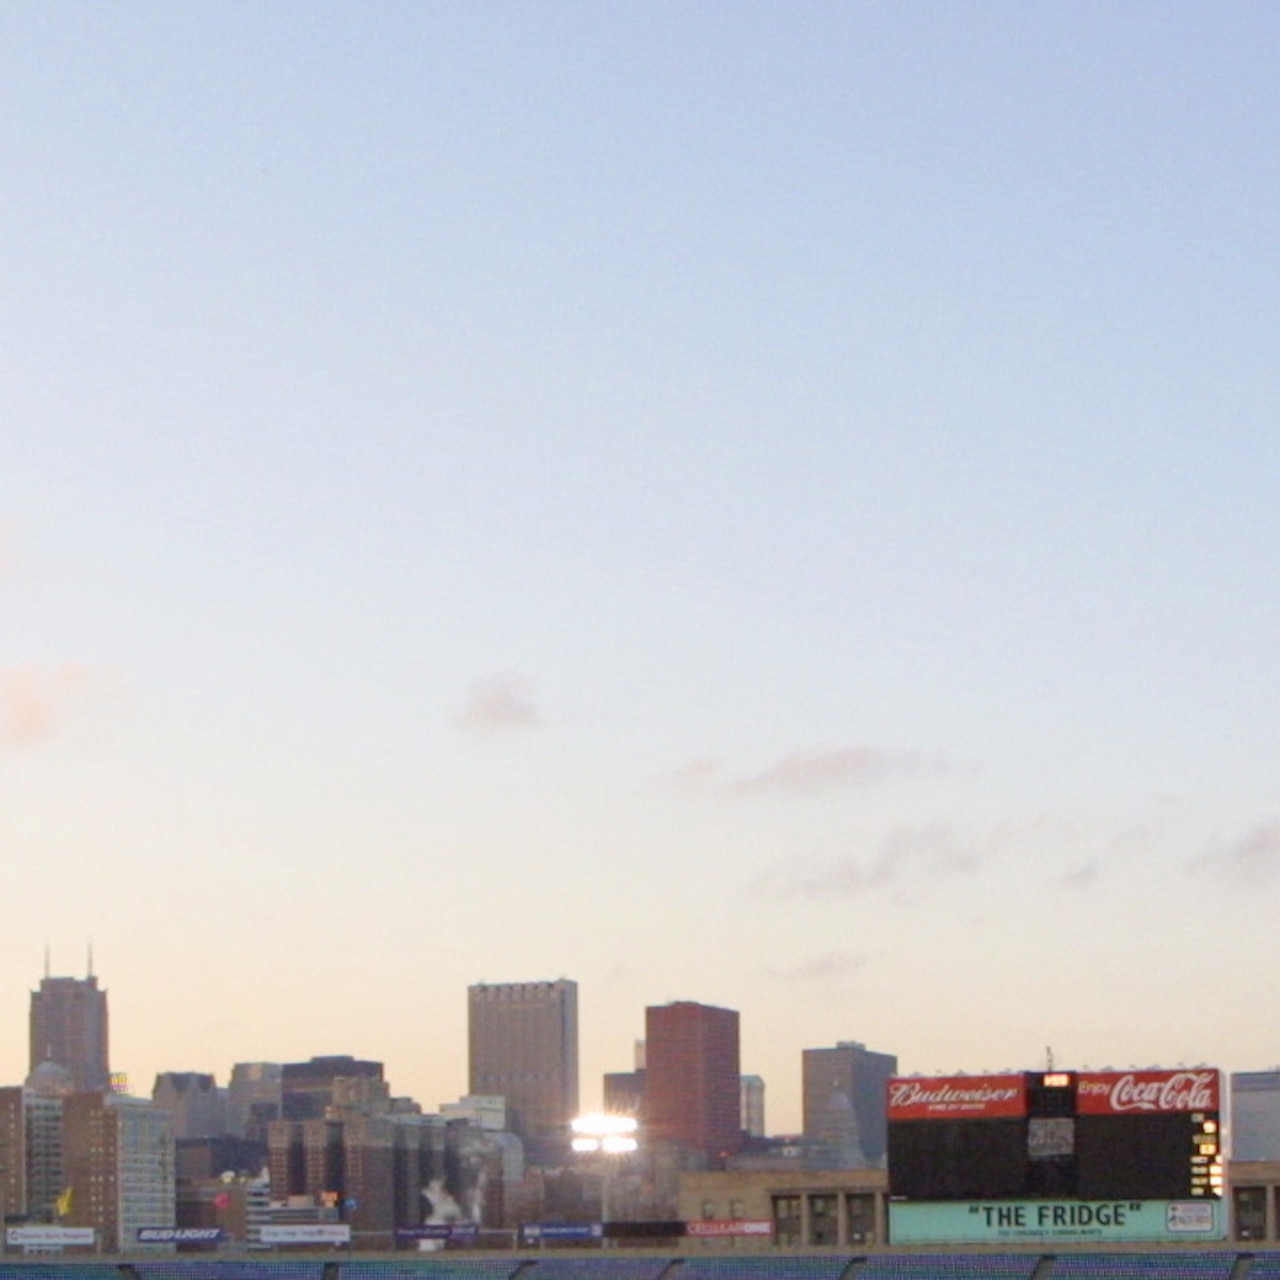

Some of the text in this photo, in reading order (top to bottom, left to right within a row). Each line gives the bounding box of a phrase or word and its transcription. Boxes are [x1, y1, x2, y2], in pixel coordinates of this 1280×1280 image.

[890, 1083, 1018, 1107] Budweiser
[1110, 1072, 1215, 1111] Coca-Cola
[175, 1229, 220, 1239] LIGHT
